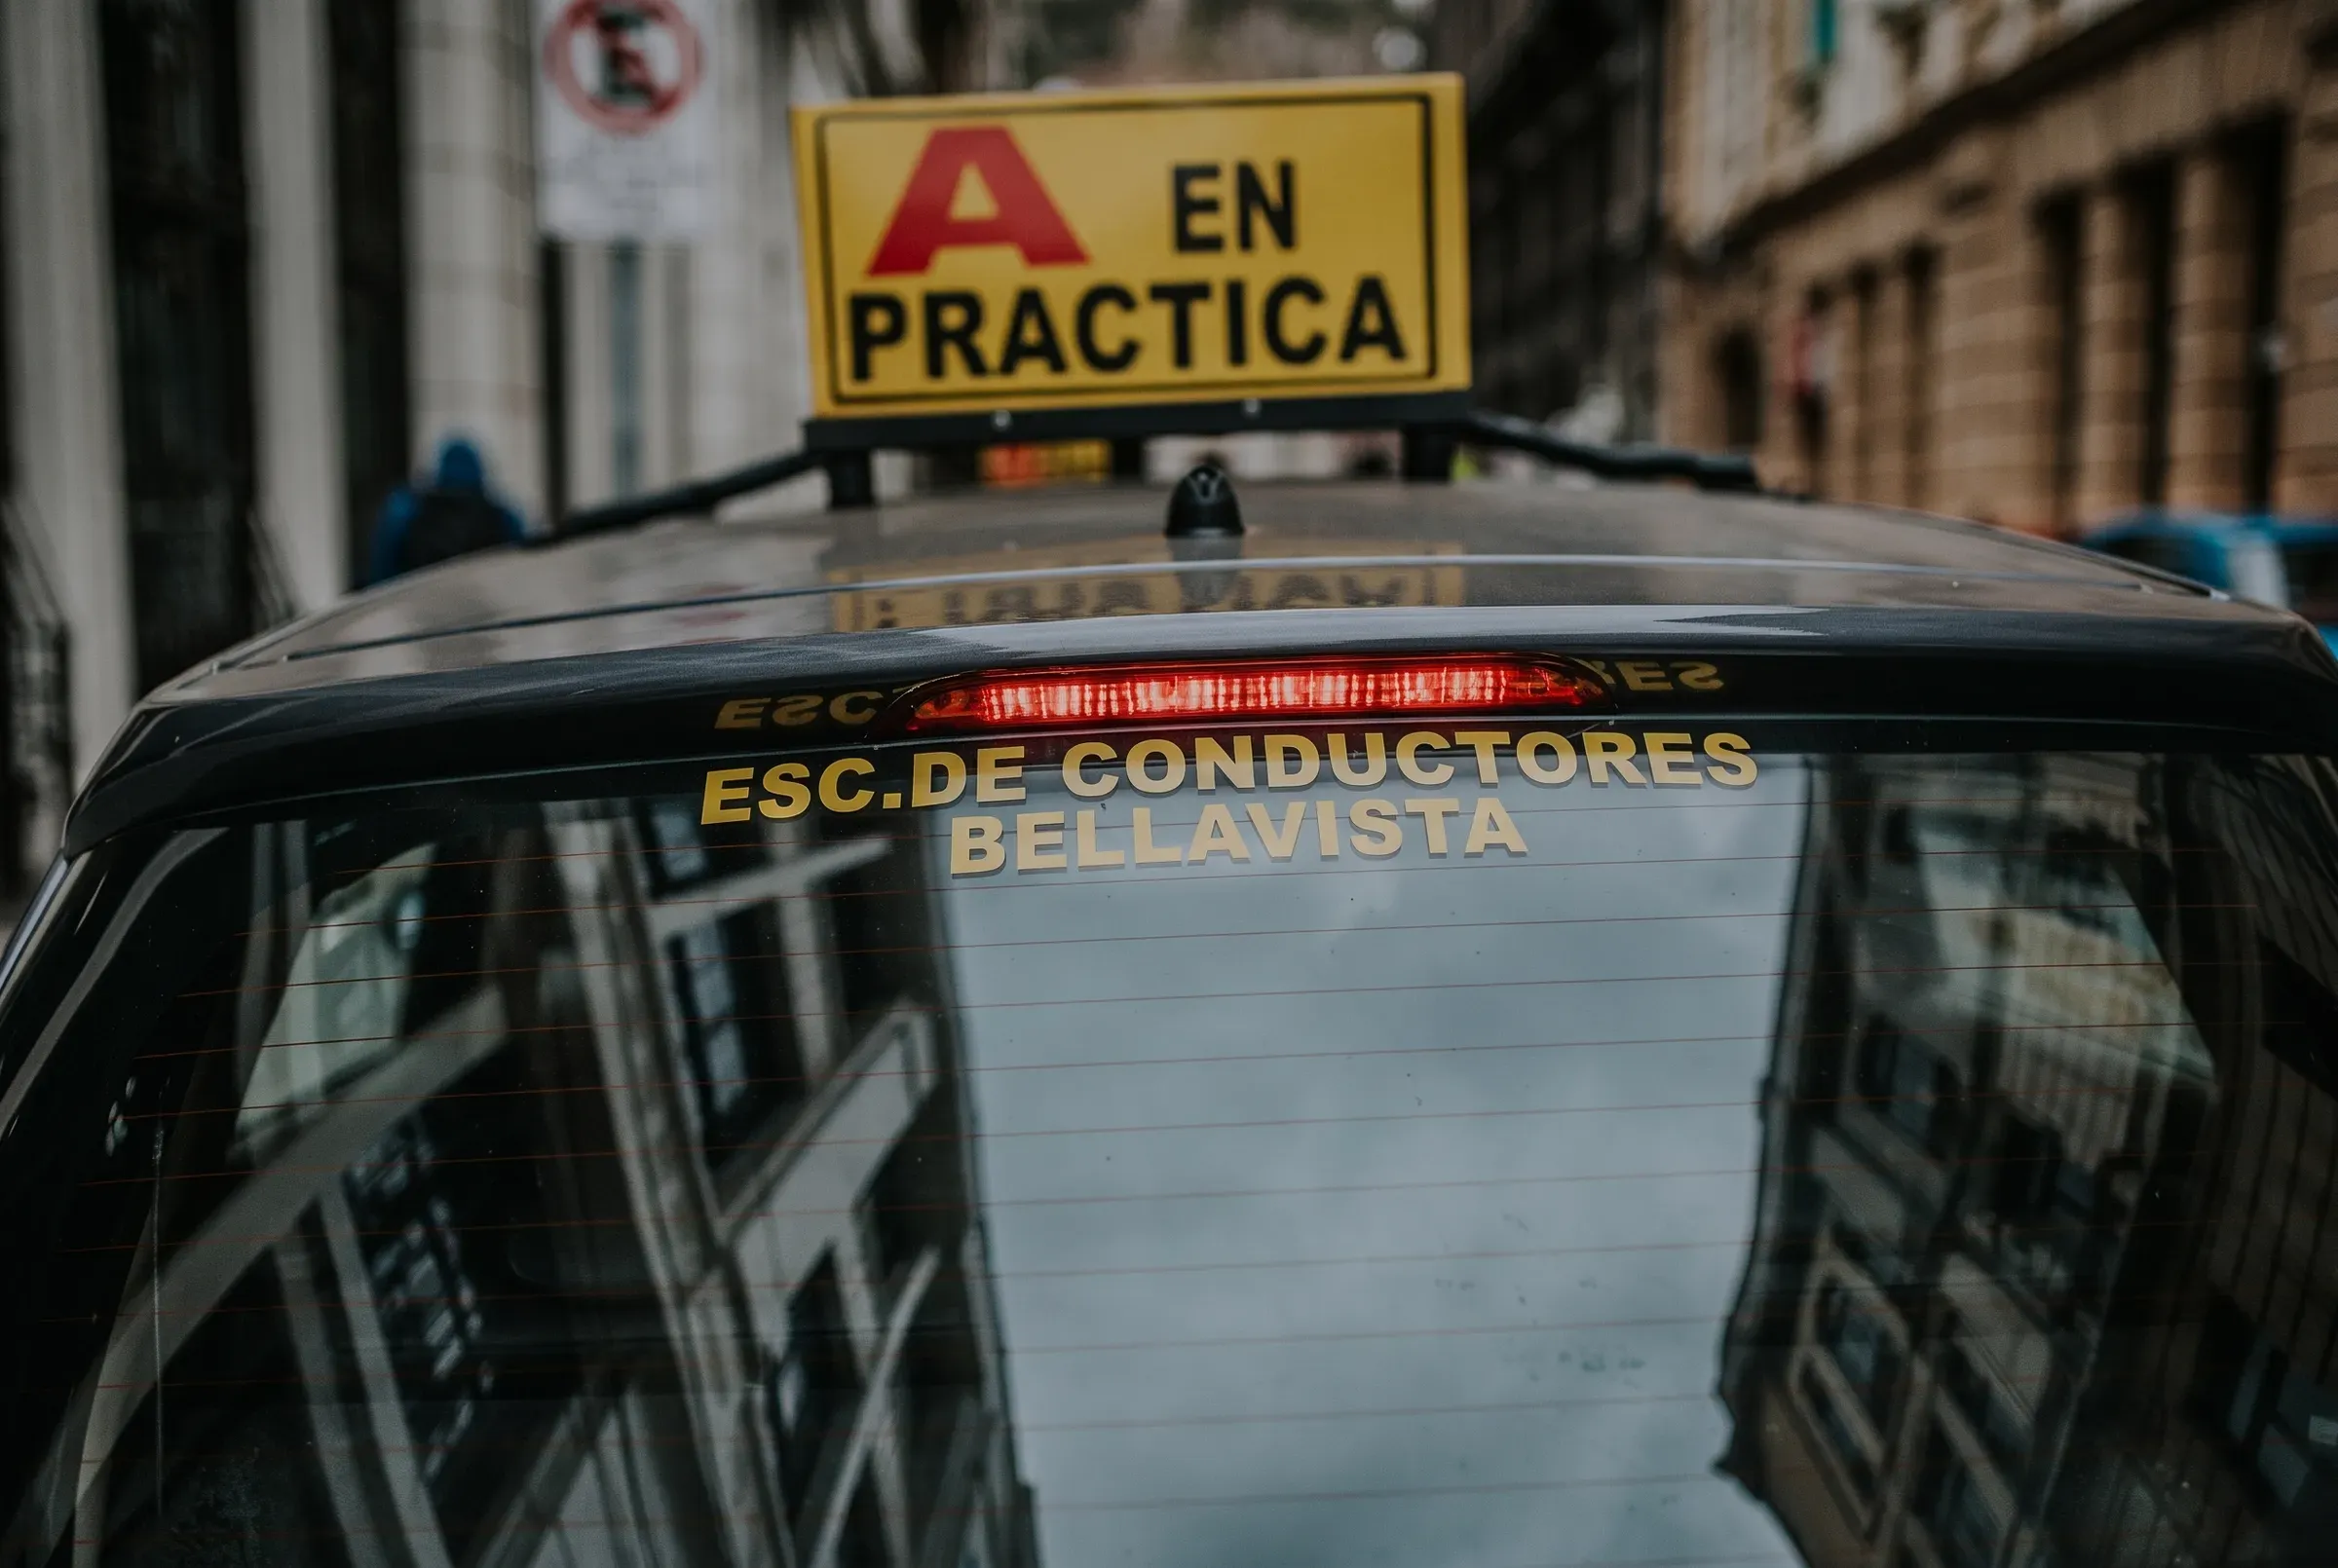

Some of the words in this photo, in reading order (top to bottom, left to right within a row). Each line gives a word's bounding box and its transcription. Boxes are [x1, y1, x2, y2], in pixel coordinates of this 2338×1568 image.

[865, 125, 1091, 279] A
[1171, 160, 1297, 254] EN
[848, 276, 1409, 383] PRACTICA
[700, 745, 1028, 825] ESC.DE
[1062, 730, 1757, 797] CONDUCTORES
[950, 797, 1528, 875] BELLAVISTA
